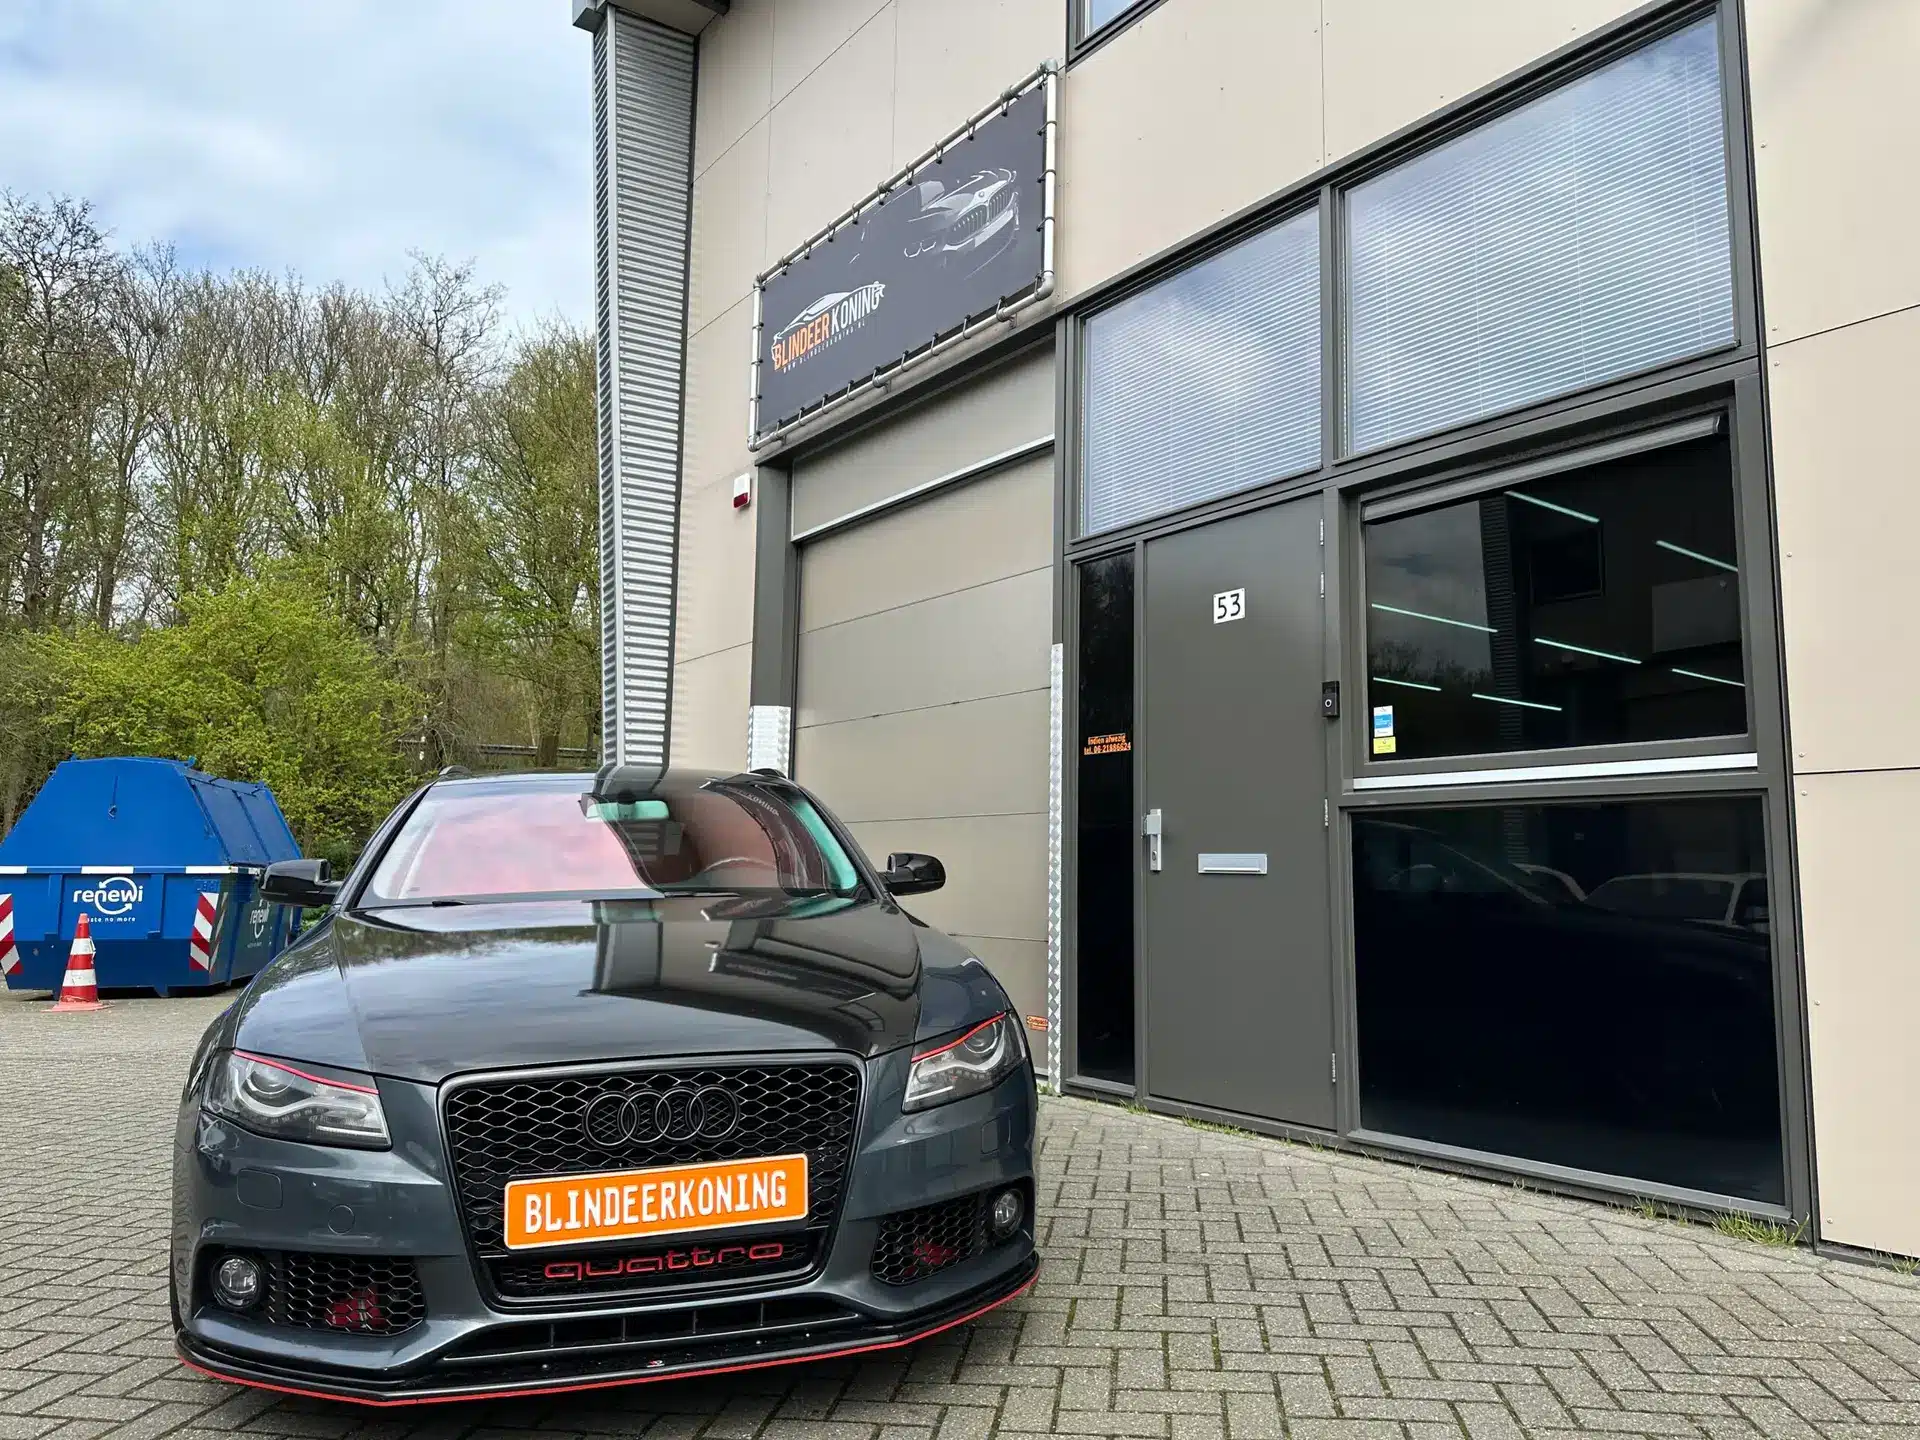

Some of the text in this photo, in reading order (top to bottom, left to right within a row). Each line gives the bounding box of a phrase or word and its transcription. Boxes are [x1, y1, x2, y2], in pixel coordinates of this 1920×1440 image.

[1217, 592, 1241, 620] 53
[73, 885, 144, 903] renewi
[524, 1169, 788, 1235] BLINDEERKONING
[543, 1242, 785, 1281] quattro
